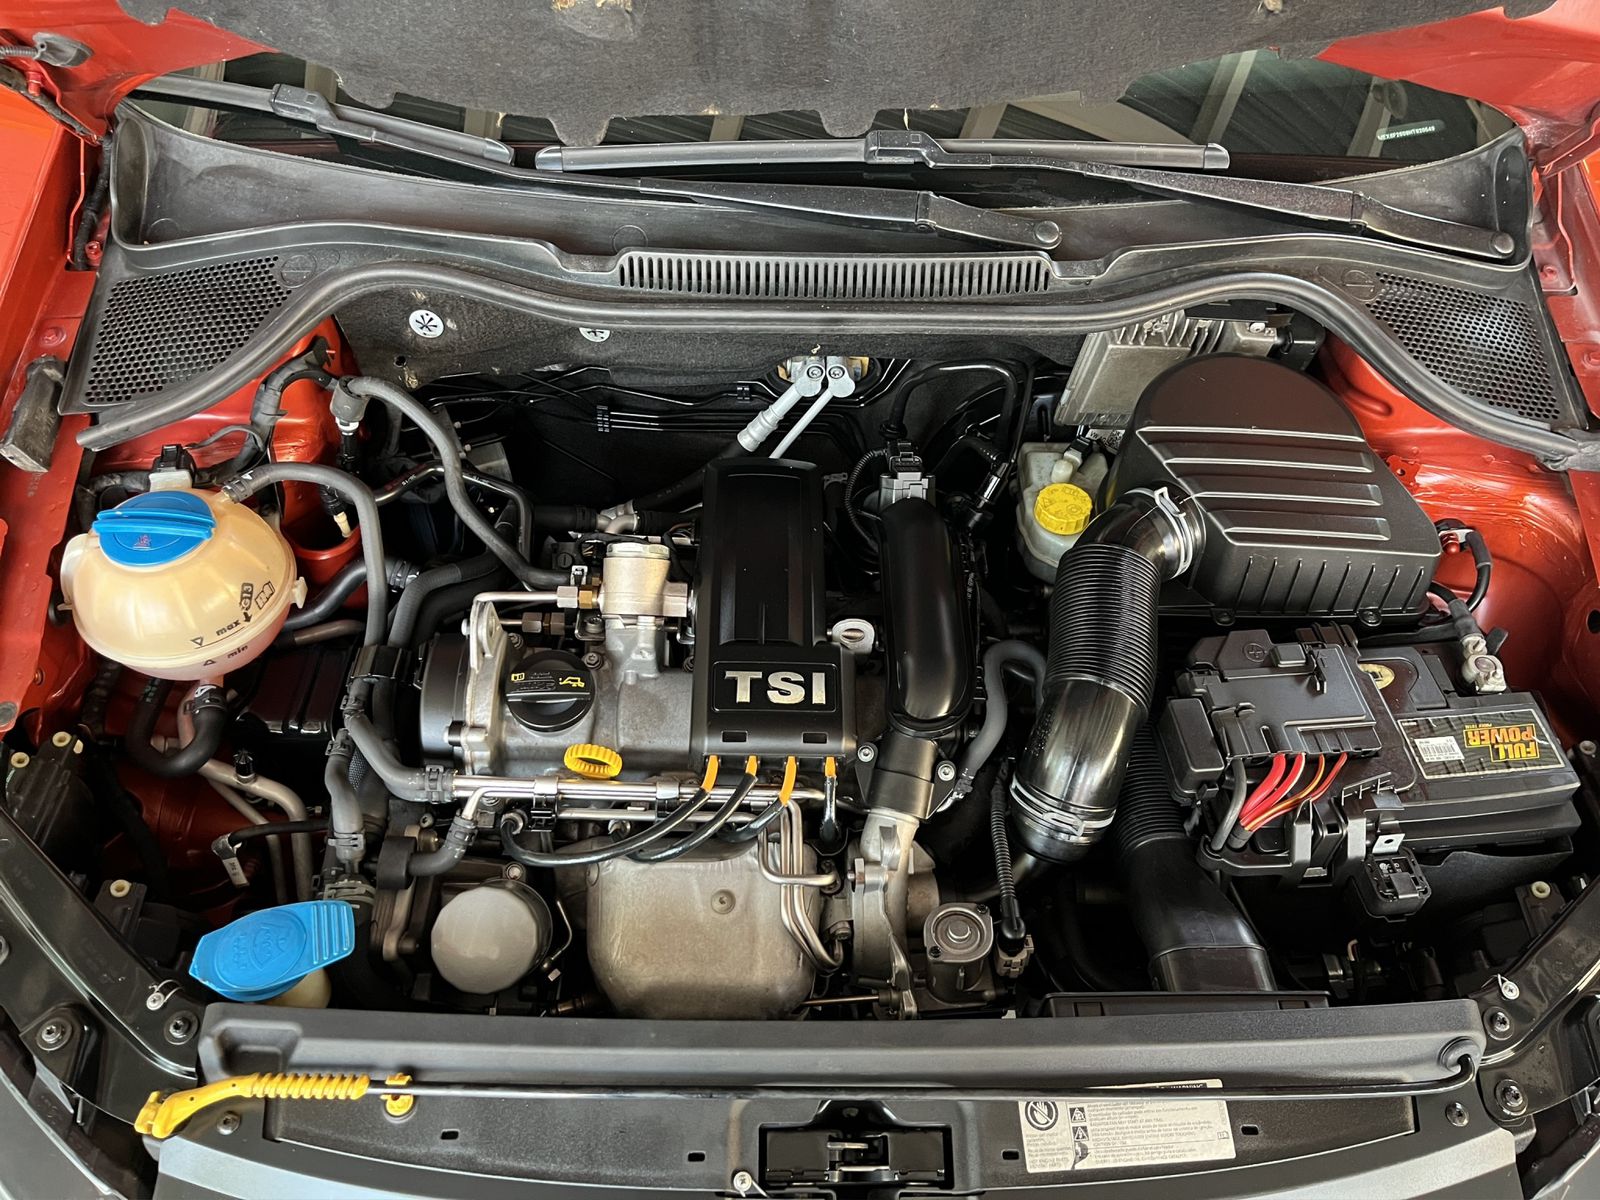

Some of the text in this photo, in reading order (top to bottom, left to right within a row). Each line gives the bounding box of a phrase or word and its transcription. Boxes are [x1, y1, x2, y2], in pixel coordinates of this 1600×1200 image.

[242, 585, 252, 607] G13
[216, 620, 241, 636] max
[227, 645, 248, 658] min
[724, 671, 826, 705] TSI
[1468, 727, 1534, 746] POWER
[1494, 742, 1537, 760] FULL
